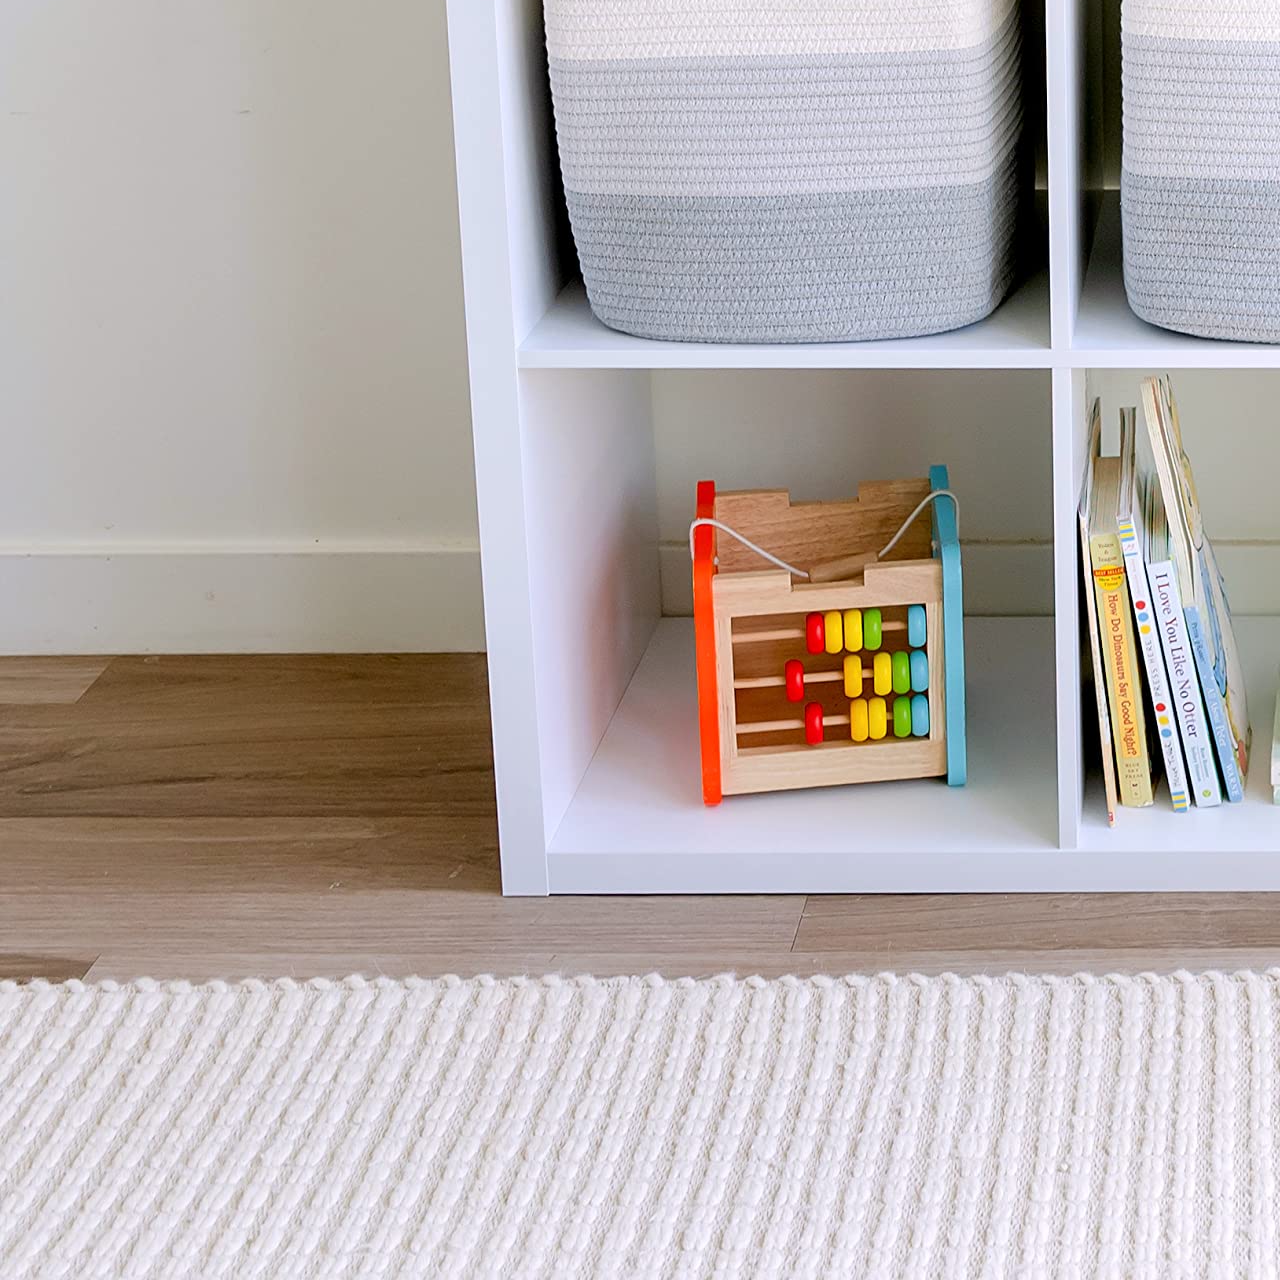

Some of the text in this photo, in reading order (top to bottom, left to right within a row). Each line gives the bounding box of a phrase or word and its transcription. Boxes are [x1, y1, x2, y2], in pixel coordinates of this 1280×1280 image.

[1157, 582, 1172, 615] Love
[1165, 617, 1178, 644] You
[1107, 594, 1138, 757] How Do Dinosaurs Say Good Night?
[1144, 639, 1162, 697] PRESS HERE
[1171, 646, 1187, 677] Like
[1178, 679, 1192, 699] No
[1182, 702, 1198, 738] Otter
